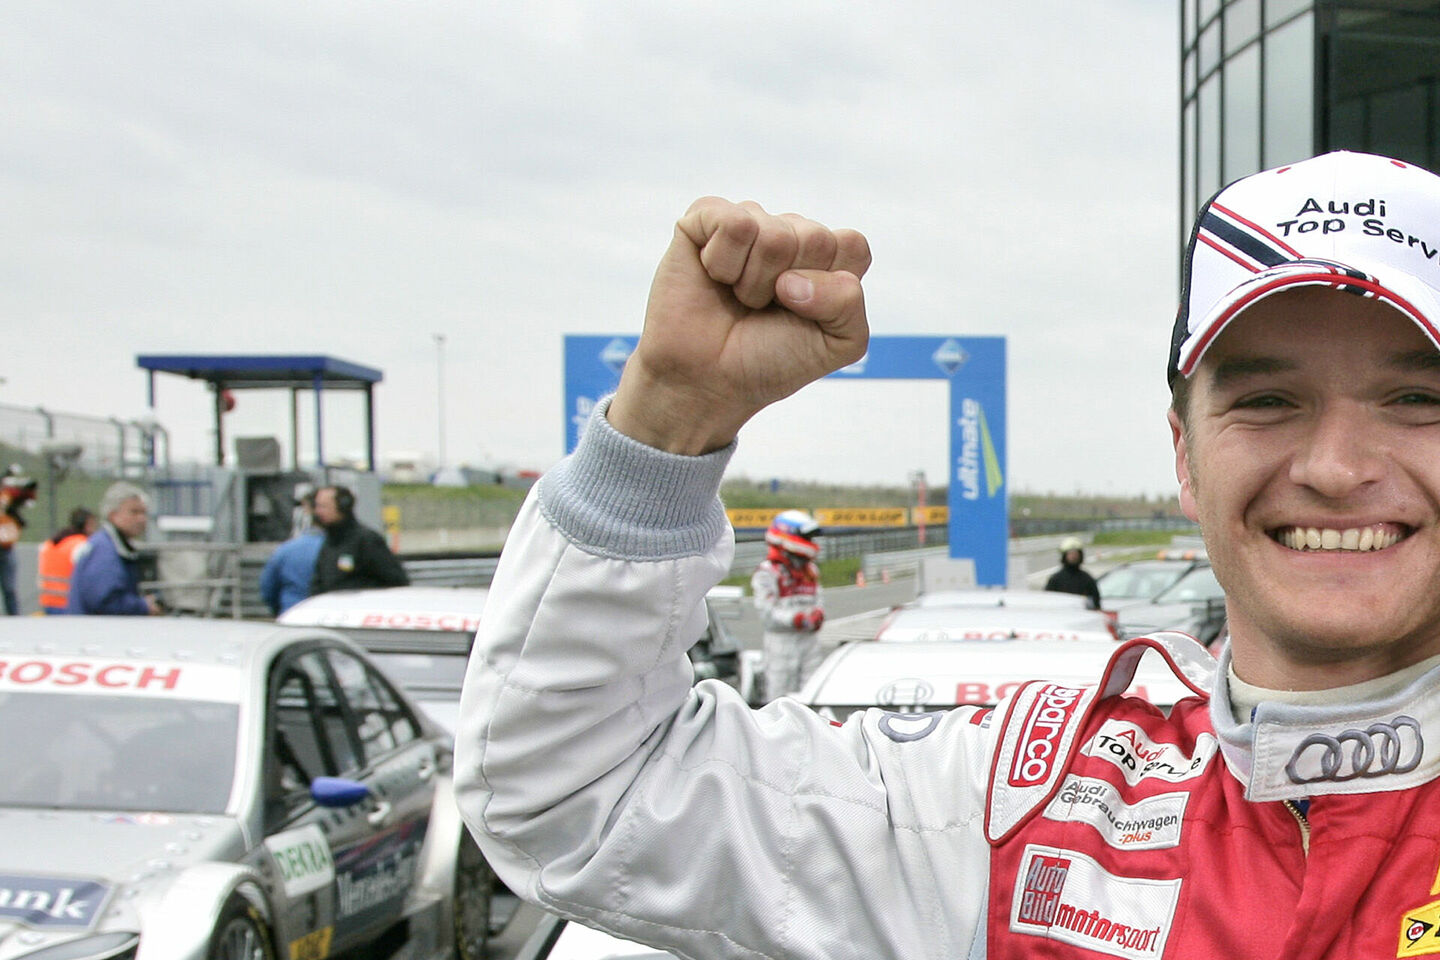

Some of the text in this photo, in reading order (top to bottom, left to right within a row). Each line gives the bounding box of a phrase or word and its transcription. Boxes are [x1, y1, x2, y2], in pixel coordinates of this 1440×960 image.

[1296, 198, 1386, 217] Audi
[1277, 219, 1345, 237] Top
[957, 398, 979, 500] ultimate
[0, 660, 181, 691] OSCH
[1014, 684, 1081, 781] sparco
[1115, 729, 1169, 763] Audi
[1098, 735, 1137, 770] Top
[1065, 781, 1108, 797] Audi
[1060, 791, 1178, 833] Gebrauchtwagen
[1026, 857, 1068, 894] Auto
[1020, 891, 1161, 952] Bild motorsport
